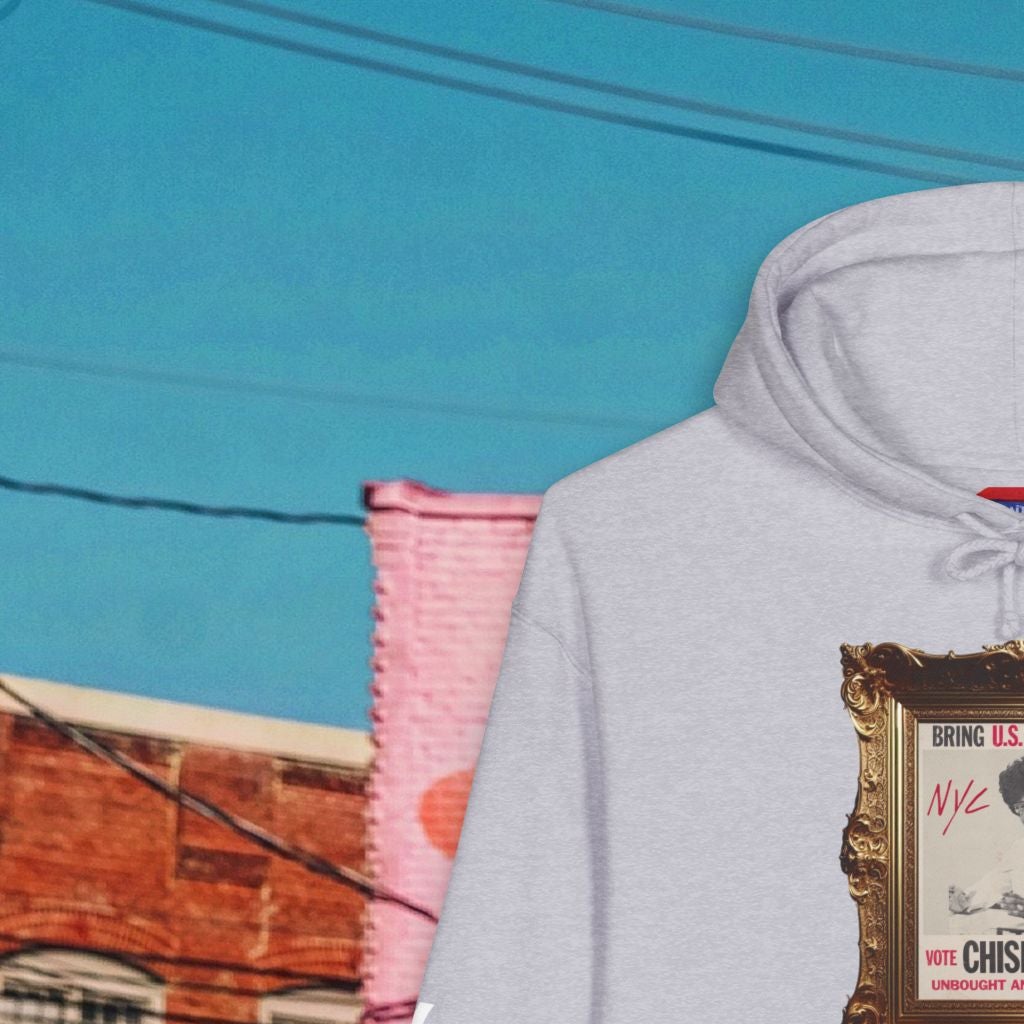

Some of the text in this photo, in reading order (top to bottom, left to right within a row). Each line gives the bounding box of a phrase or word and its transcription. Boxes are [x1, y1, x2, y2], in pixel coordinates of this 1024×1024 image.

[932, 724, 985, 747] BRING
[992, 724, 1023, 747] U.S.
[927, 779, 990, 836] NYC
[925, 949, 957, 966] VOTE
[931, 979, 1007, 991] UNBOUGHT
